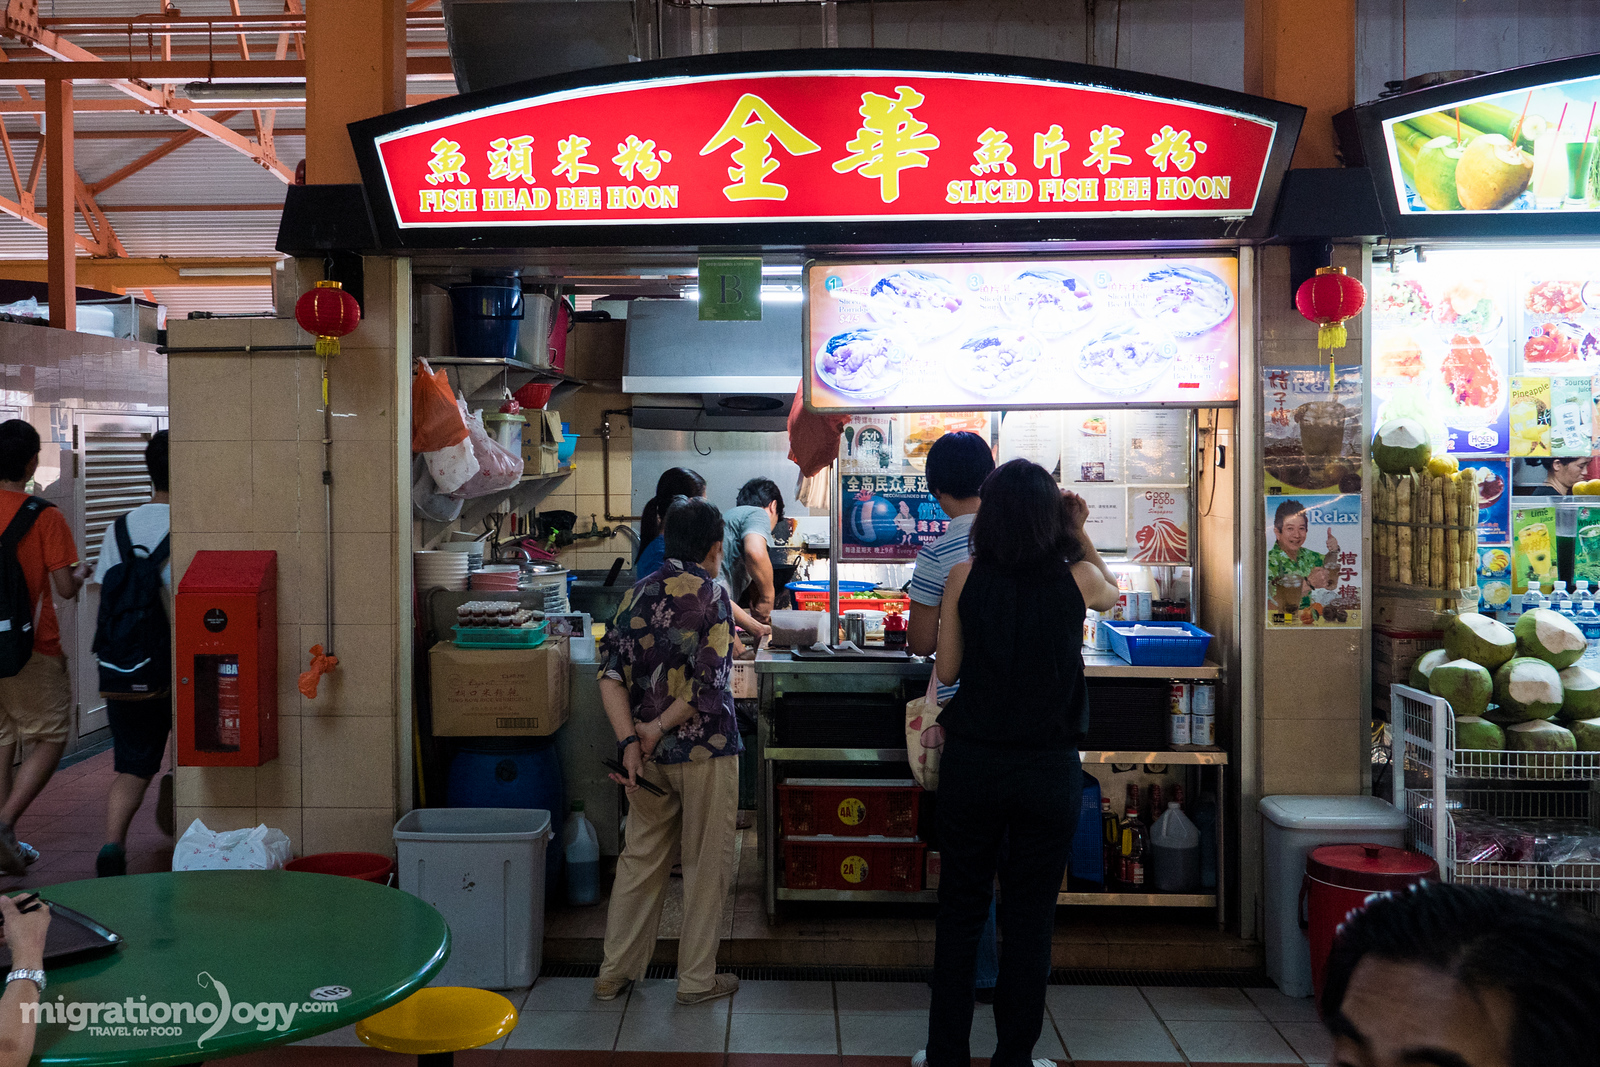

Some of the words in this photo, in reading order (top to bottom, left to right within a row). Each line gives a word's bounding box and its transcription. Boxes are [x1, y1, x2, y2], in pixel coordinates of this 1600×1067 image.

[699, 86, 940, 203] 金華
[969, 124, 1207, 177] 魚片米粉
[425, 134, 671, 186] 魚頭米粉
[946, 178, 1032, 204] SLICED
[1038, 178, 1098, 203] FISH
[1104, 177, 1151, 201] BEE
[1156, 176, 1231, 200] HOON
[419, 188, 477, 212] FISH
[482, 188, 551, 211] HEAD
[556, 186, 601, 211] BEE
[606, 186, 679, 210] HOON
[717, 274, 743, 304] B
[1512, 382, 1550, 399] Pineapple
[1471, 434, 1496, 443] HOSEN
[1152, 498, 1175, 508] FOOD
[1309, 509, 1359, 524] Relax
[1530, 509, 1549, 518] Lime
[840, 806, 851, 818] 4A
[843, 863, 854, 875] 2A
[315, 986, 348, 998] 103
